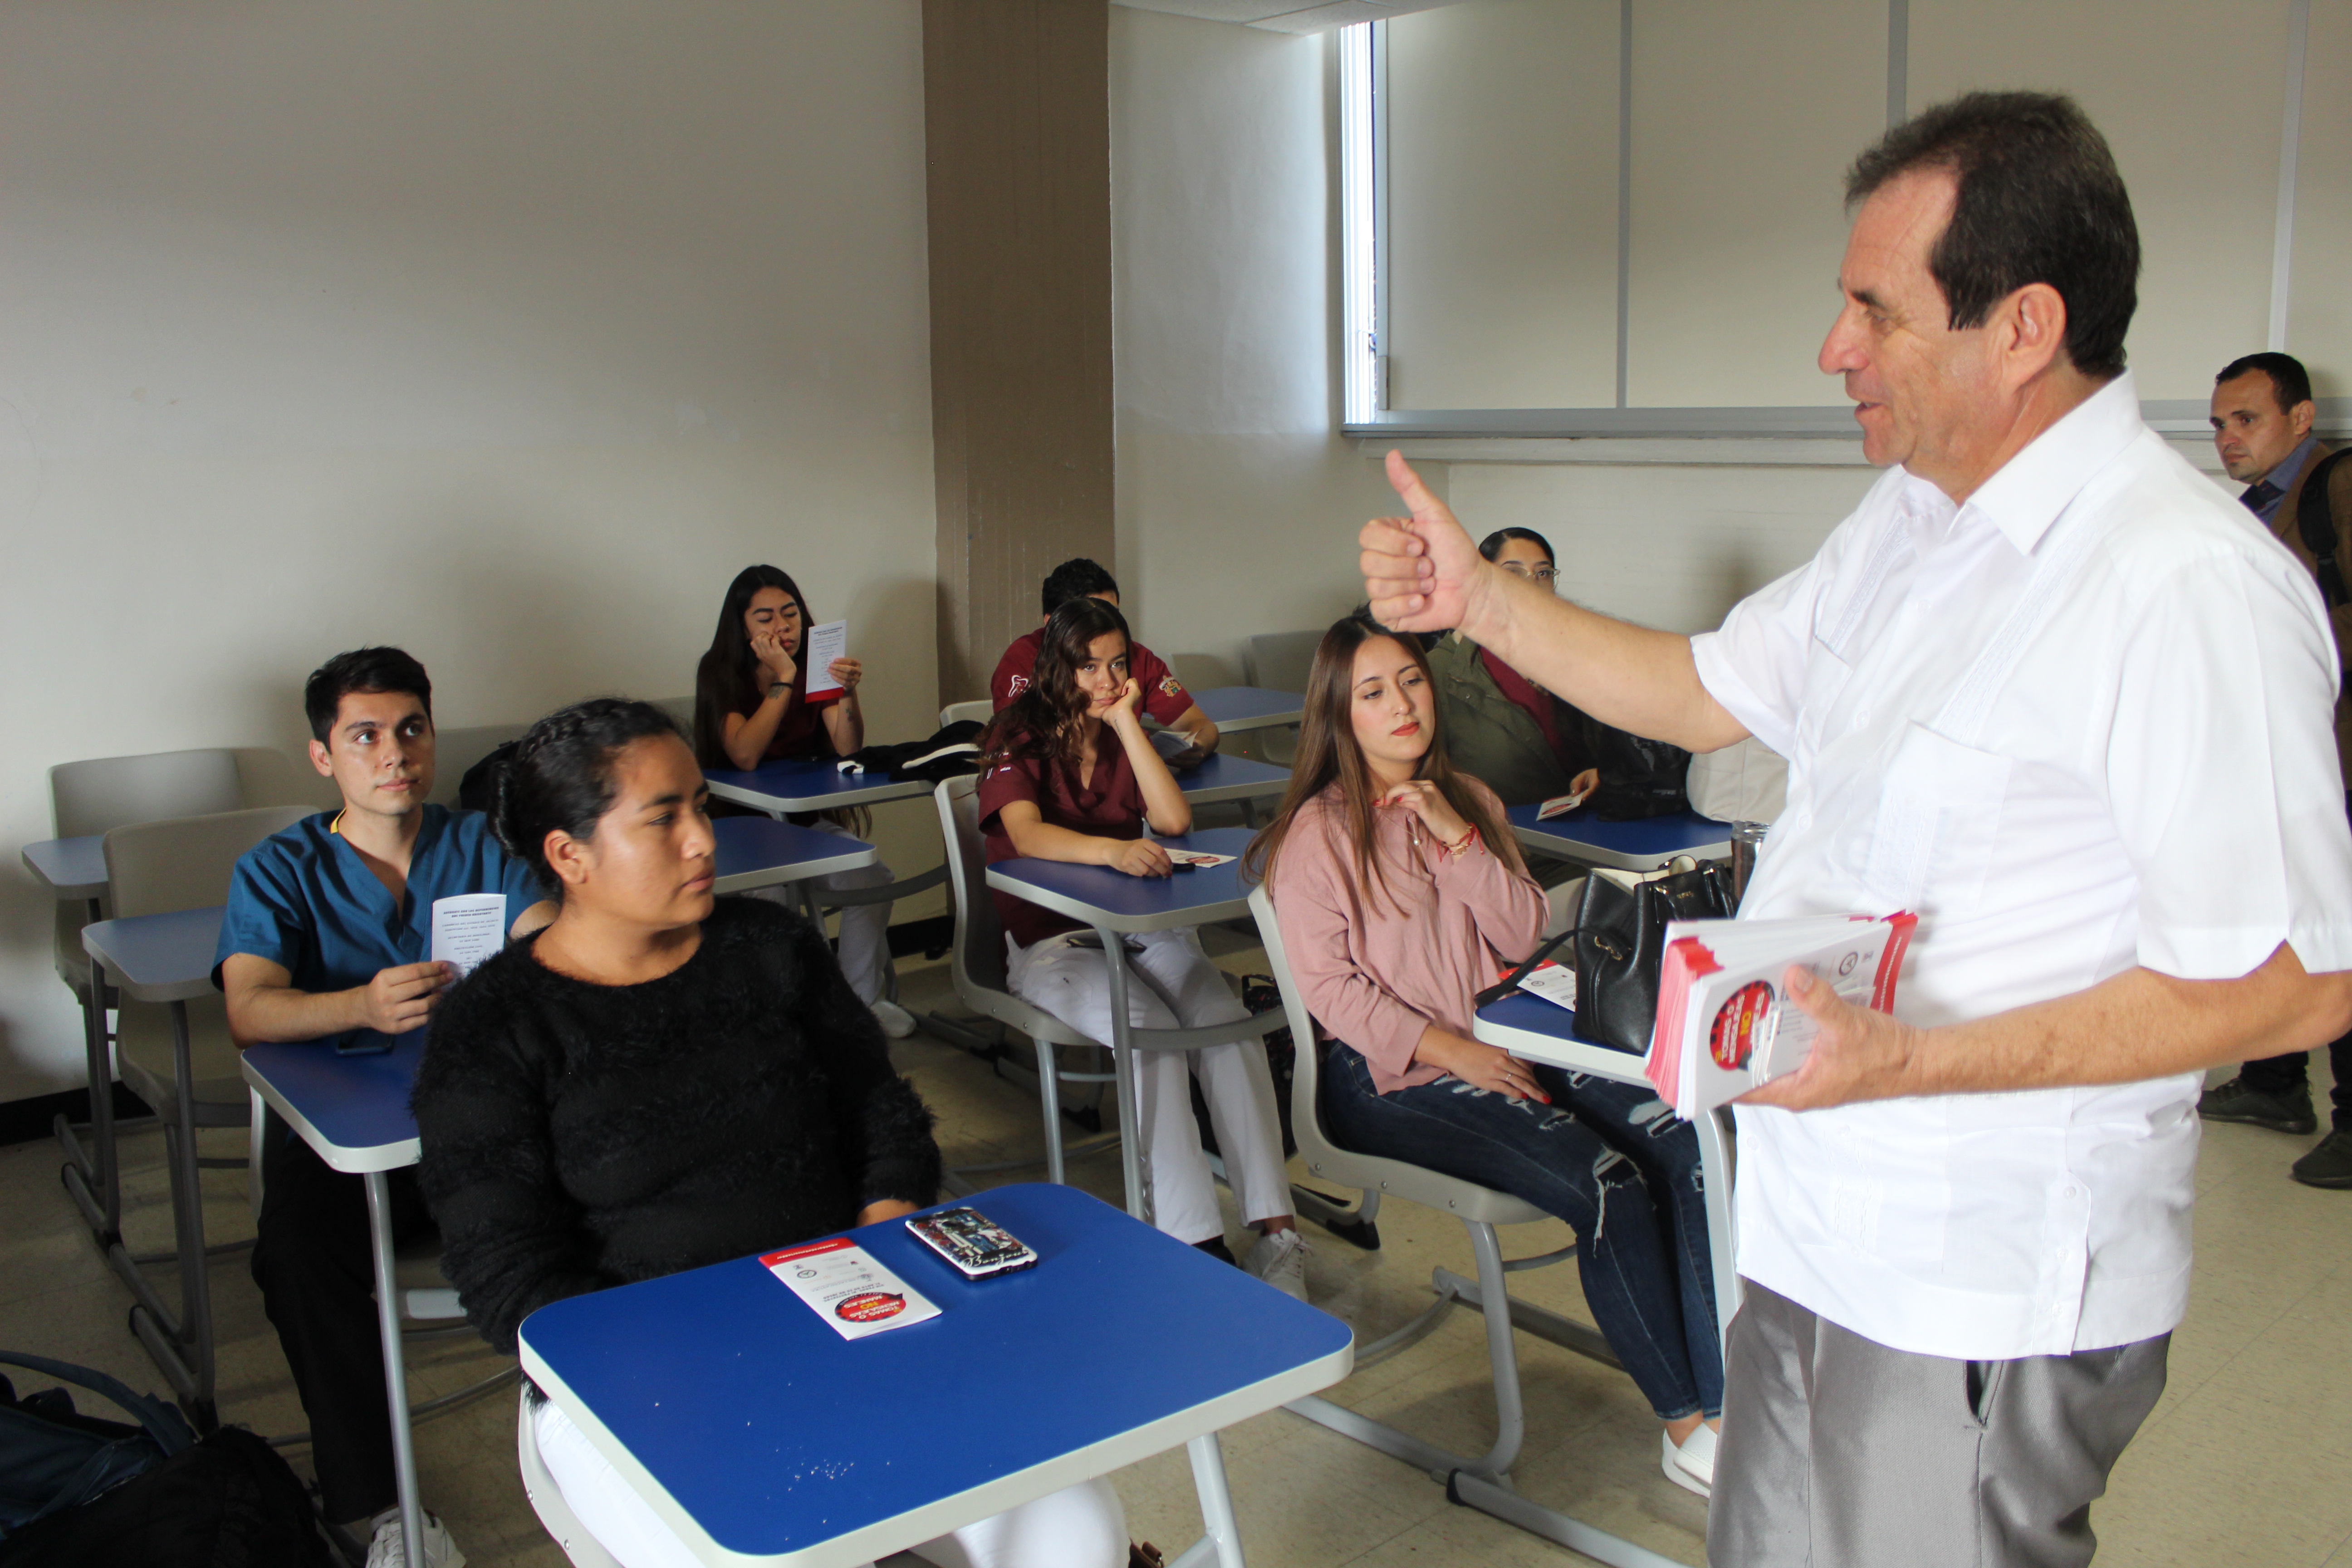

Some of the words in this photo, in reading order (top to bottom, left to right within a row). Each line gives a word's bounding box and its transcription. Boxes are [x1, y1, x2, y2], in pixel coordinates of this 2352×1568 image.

[1729, 994, 1745, 1063] MENSAJEAS
[1740, 1010, 1752, 1036] NO
[1722, 1018, 1732, 1062] TOMAS
[1727, 1005, 1735, 1015] O
[962, 1250, 1029, 1267] Bonjour
[844, 1295, 883, 1308] MANEJES
[849, 1301, 900, 1318] MENSAJEAS
[868, 1306, 900, 1316] TOMAS
